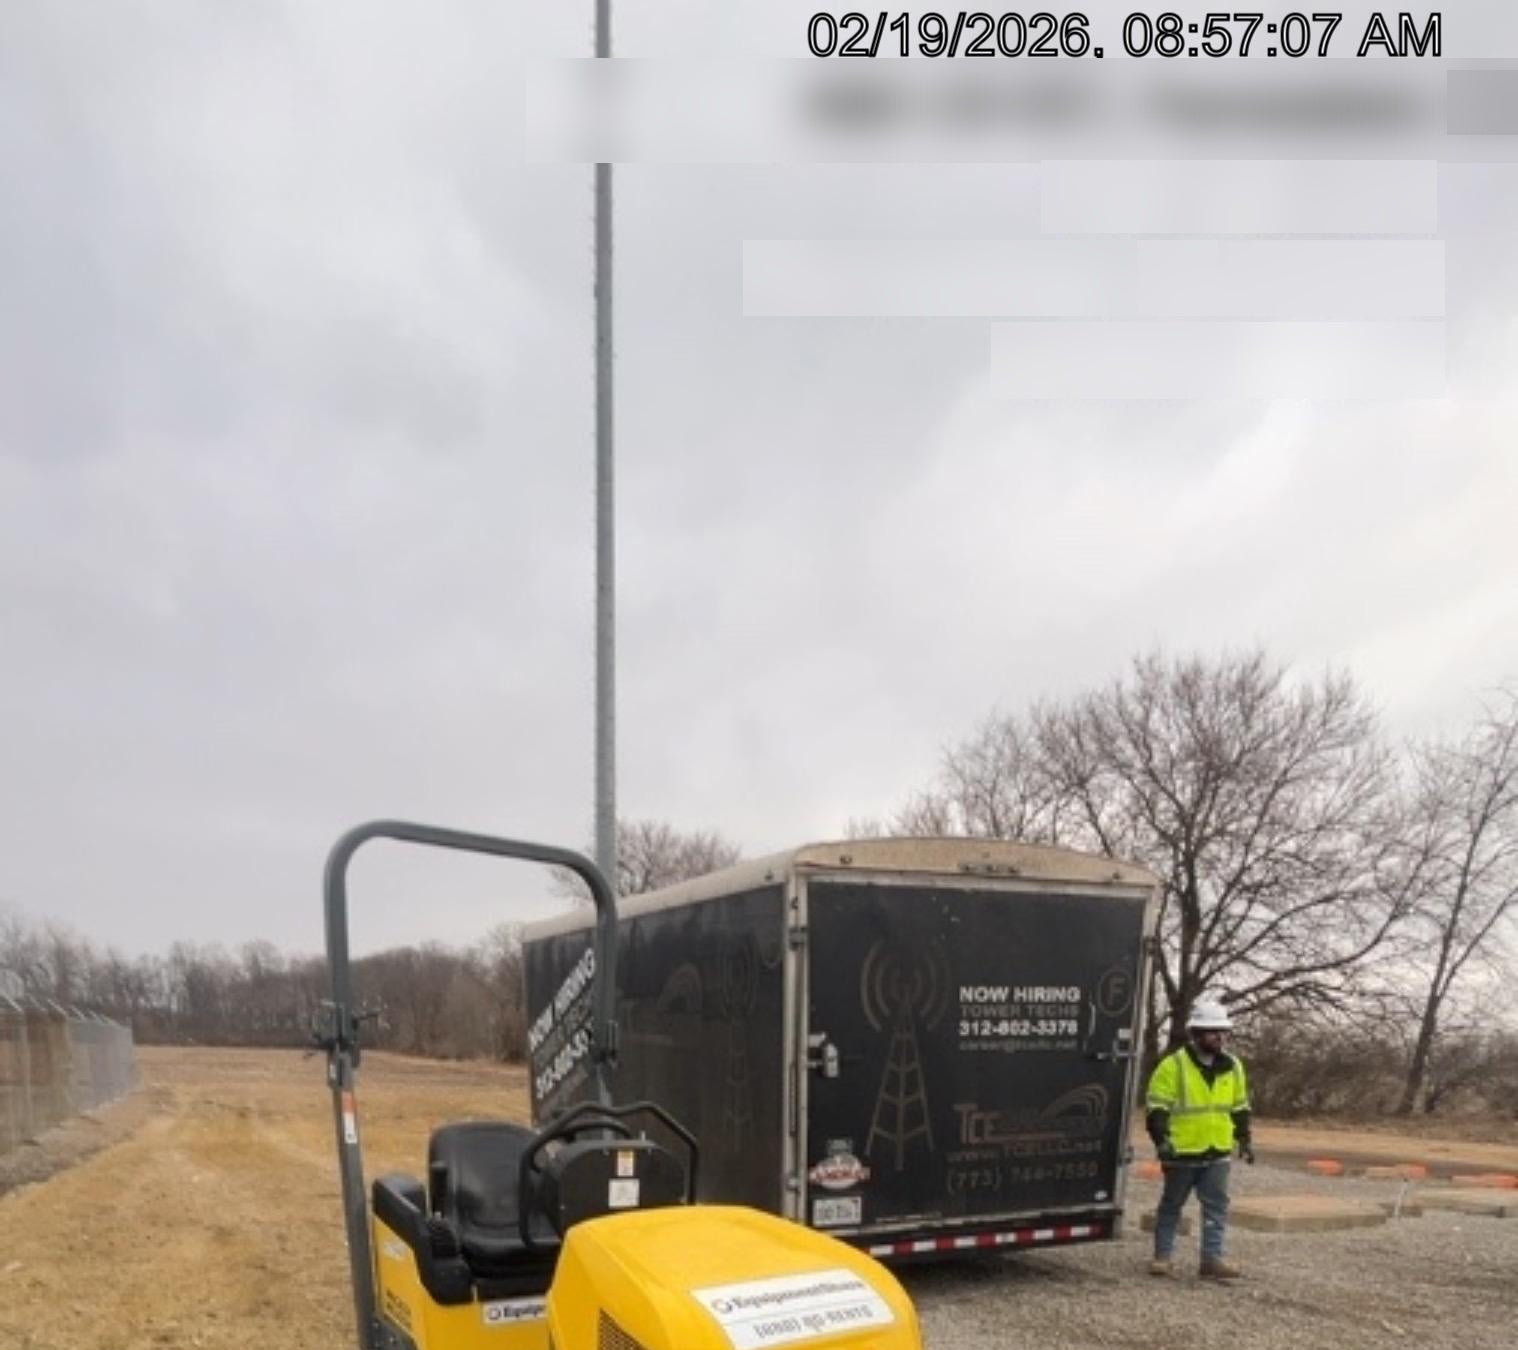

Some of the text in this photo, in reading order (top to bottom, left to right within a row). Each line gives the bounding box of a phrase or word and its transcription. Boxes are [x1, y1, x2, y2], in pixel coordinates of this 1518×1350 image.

[960, 986, 1081, 1003] NOW HIRING
[960, 1003, 1079, 1019] TOWER TECHS
